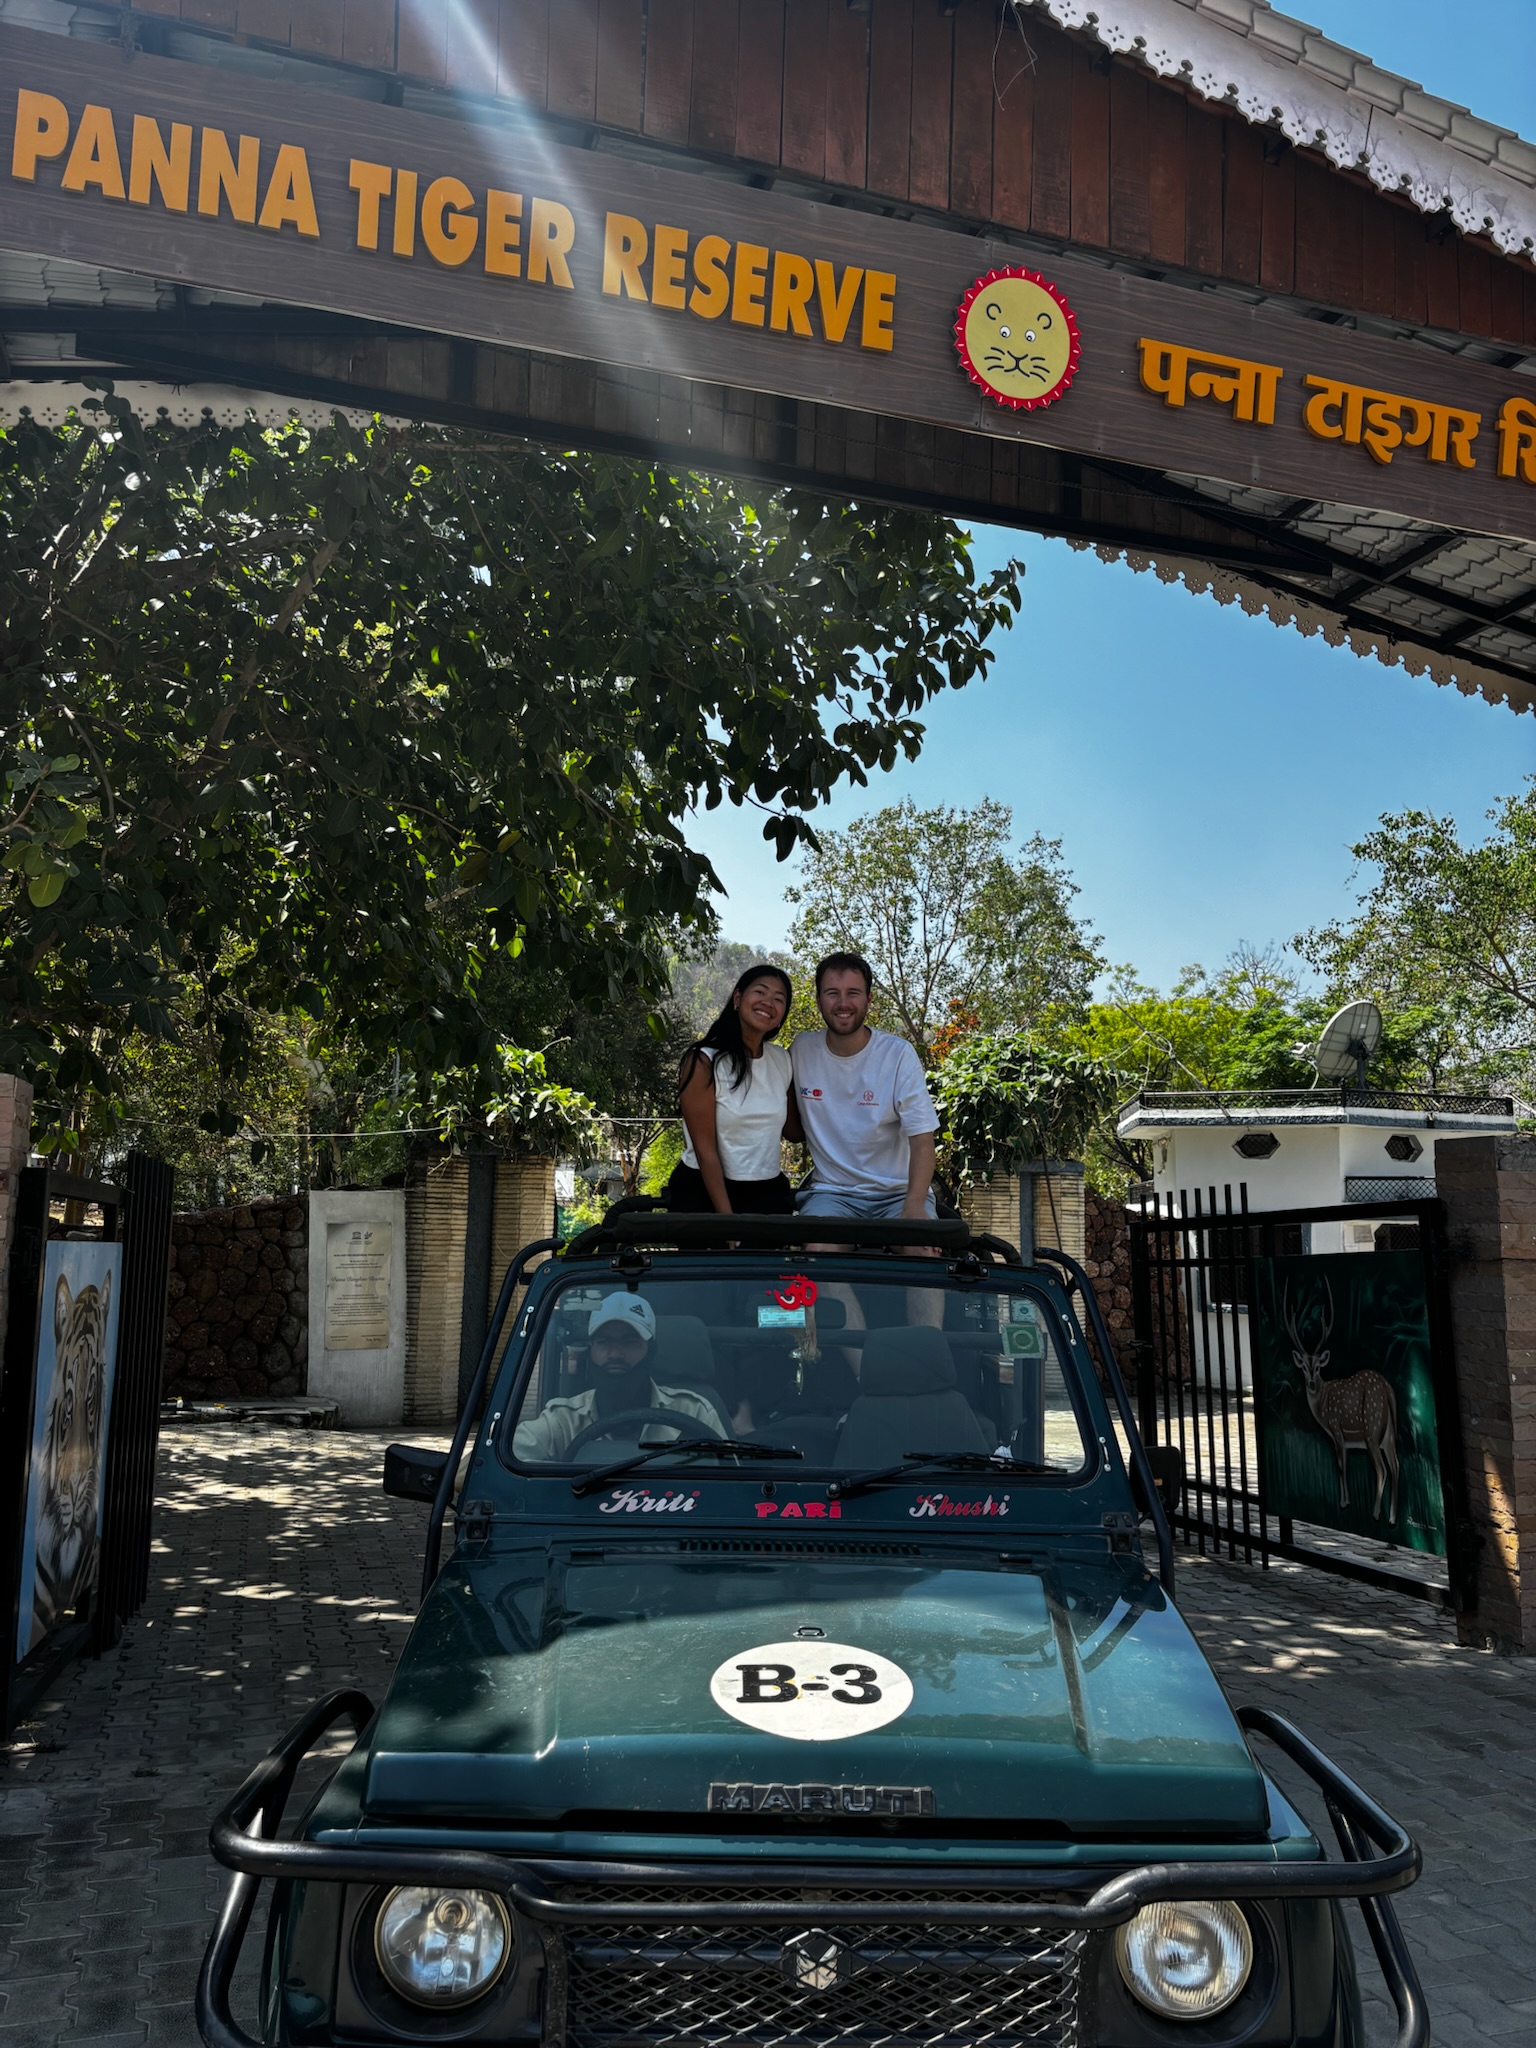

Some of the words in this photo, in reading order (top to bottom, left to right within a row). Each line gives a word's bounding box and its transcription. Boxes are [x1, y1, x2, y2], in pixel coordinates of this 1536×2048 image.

[11, 88, 321, 239] PANNA
[349, 158, 576, 290] TIGER
[602, 211, 897, 352] RESERVE
[1137, 337, 1284, 426] पन्ना
[1303, 373, 1482, 469] टाइगर
[598, 1489, 701, 1514] Kriti
[908, 1493, 1011, 1518] Khushi
[735, 1663, 882, 1704] B-3
[707, 1783, 936, 1817] MARUTI
